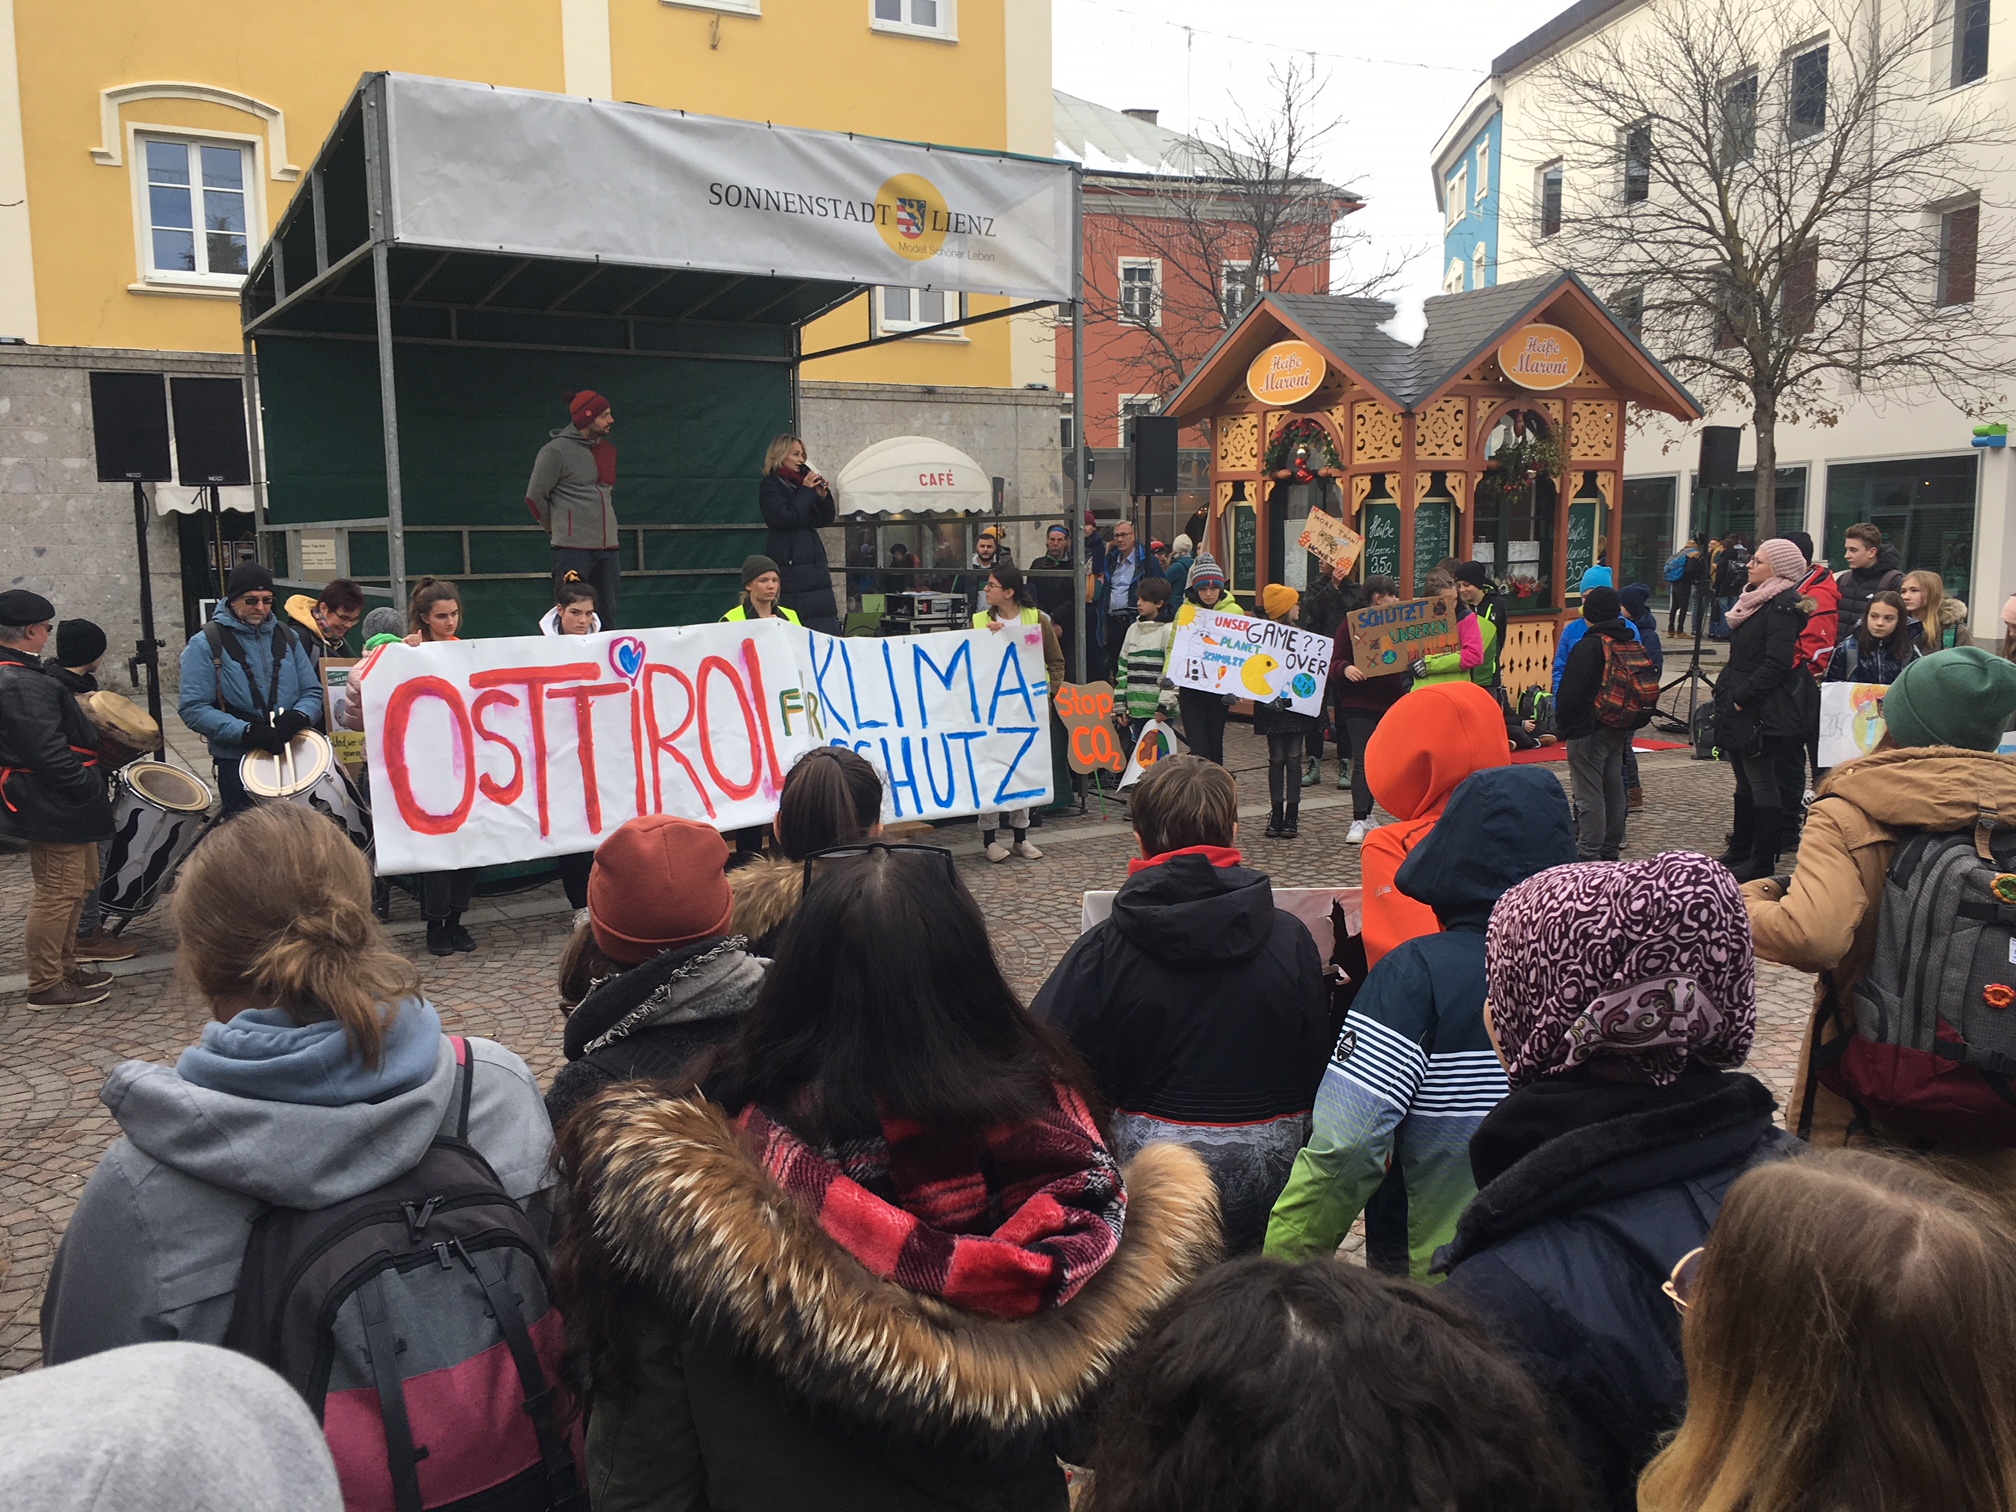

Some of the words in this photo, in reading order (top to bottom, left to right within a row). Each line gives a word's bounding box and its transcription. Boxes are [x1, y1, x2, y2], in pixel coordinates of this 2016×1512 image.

[709, 182, 891, 226] SONNENSTADT
[931, 211, 996, 238] LIENZ
[898, 241, 928, 254] Modell
[930, 245, 965, 259] Schöner
[967, 249, 996, 262] Leben
[1525, 336, 1560, 357] Heiße
[1270, 353, 1302, 373] Heiße
[1512, 353, 1568, 375] Maroni
[1259, 370, 1311, 393] Maroni
[919, 469, 955, 487] CAFÉ
[1313, 514, 1334, 530] MORE
[1307, 543, 1336, 563] HONEY
[1215, 616, 1250, 631] UNSER
[1358, 601, 1429, 629] SCHÜTZT
[1246, 622, 1299, 653] GAME
[1389, 619, 1448, 645] UNSEREN
[1219, 636, 1262, 655] PLANET
[1285, 653, 1327, 676] OVER
[1055, 687, 1112, 720] Stop
[1819, 712, 1854, 740] 2050
